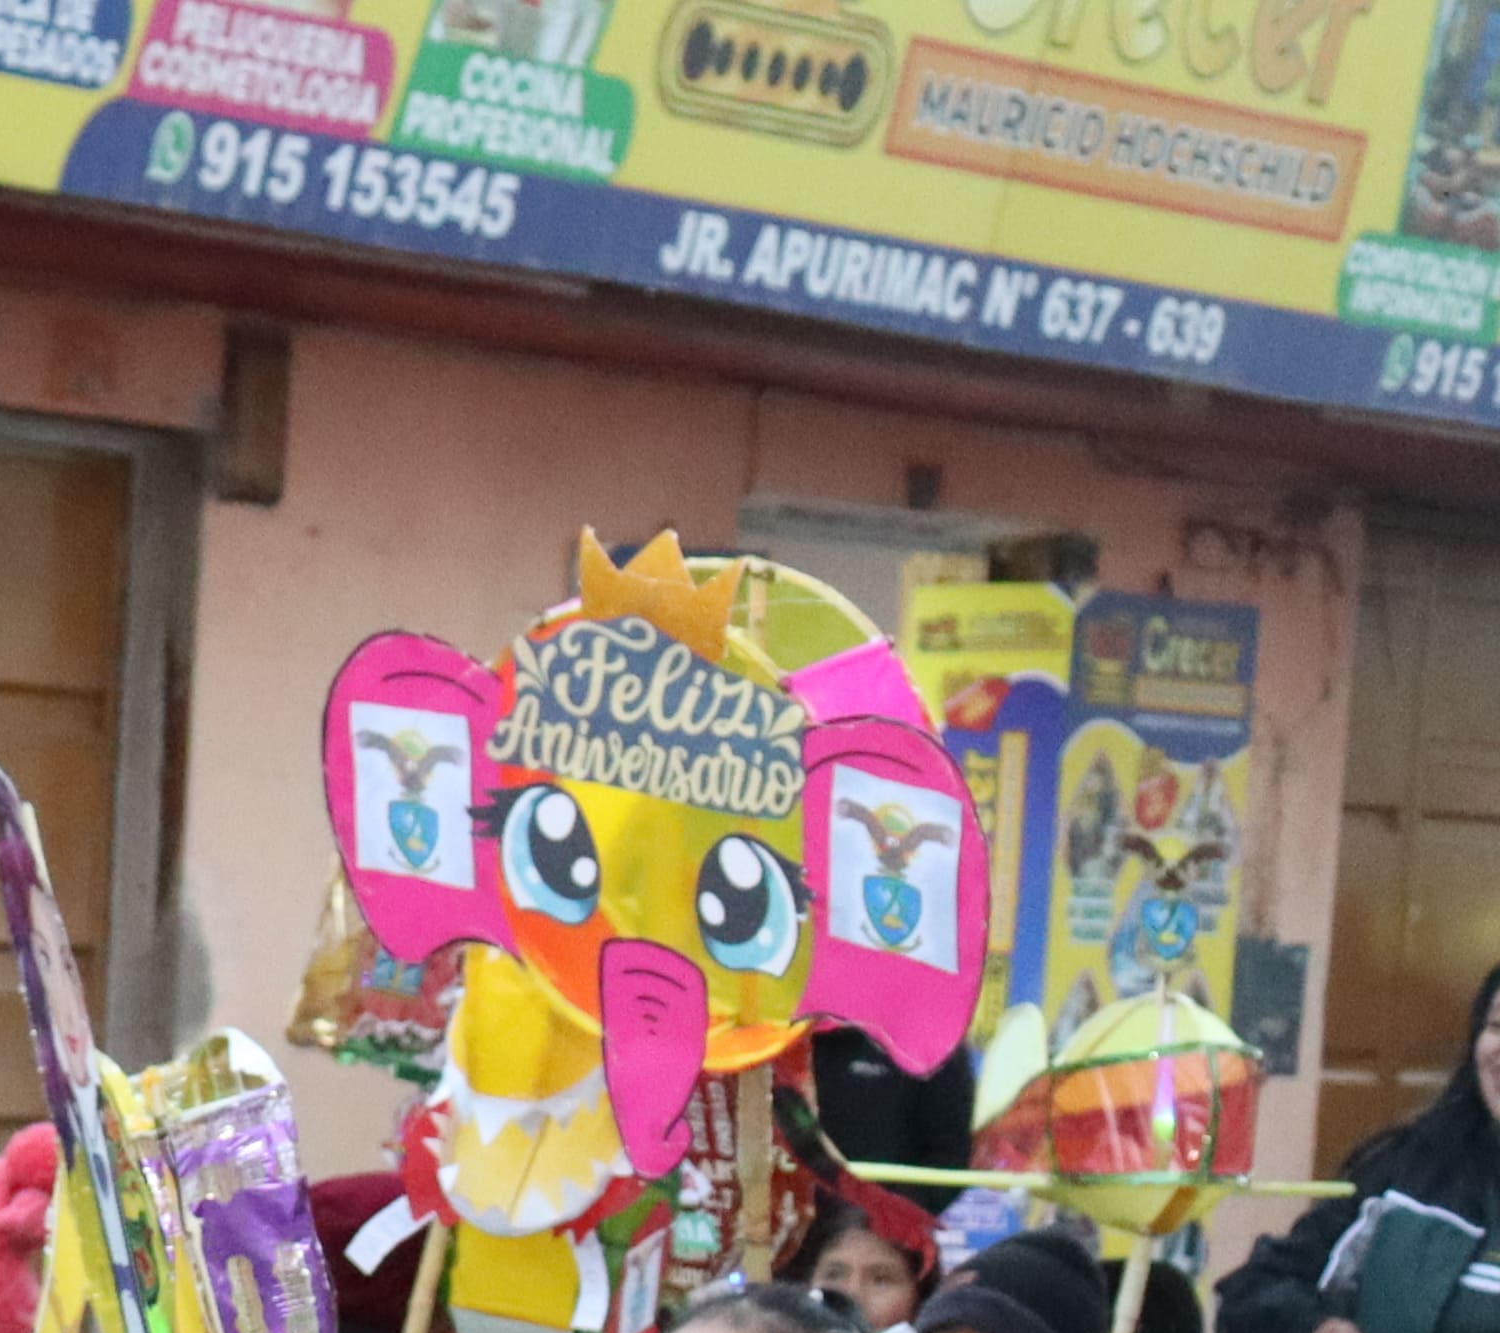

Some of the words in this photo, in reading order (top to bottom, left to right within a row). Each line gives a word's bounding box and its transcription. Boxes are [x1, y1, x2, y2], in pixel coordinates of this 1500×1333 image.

[401, 92, 618, 175] PROFESIONAL
[460, 53, 584, 117] COCINA
[914, 69, 1105, 163] MAURICIO
[1109, 110, 1338, 211] HOCHSCHILD
[199, 121, 309, 202] 915
[322, 143, 521, 238] 153545
[659, 209, 735, 282] JR.
[743, 223, 978, 323] APURIMAC
[1041, 278, 1125, 345] 637
[1145, 296, 1226, 364] 639
[1409, 339, 1488, 401] 915
[553, 616, 758, 738] Feliz
[485, 693, 806, 817] Aniversario
